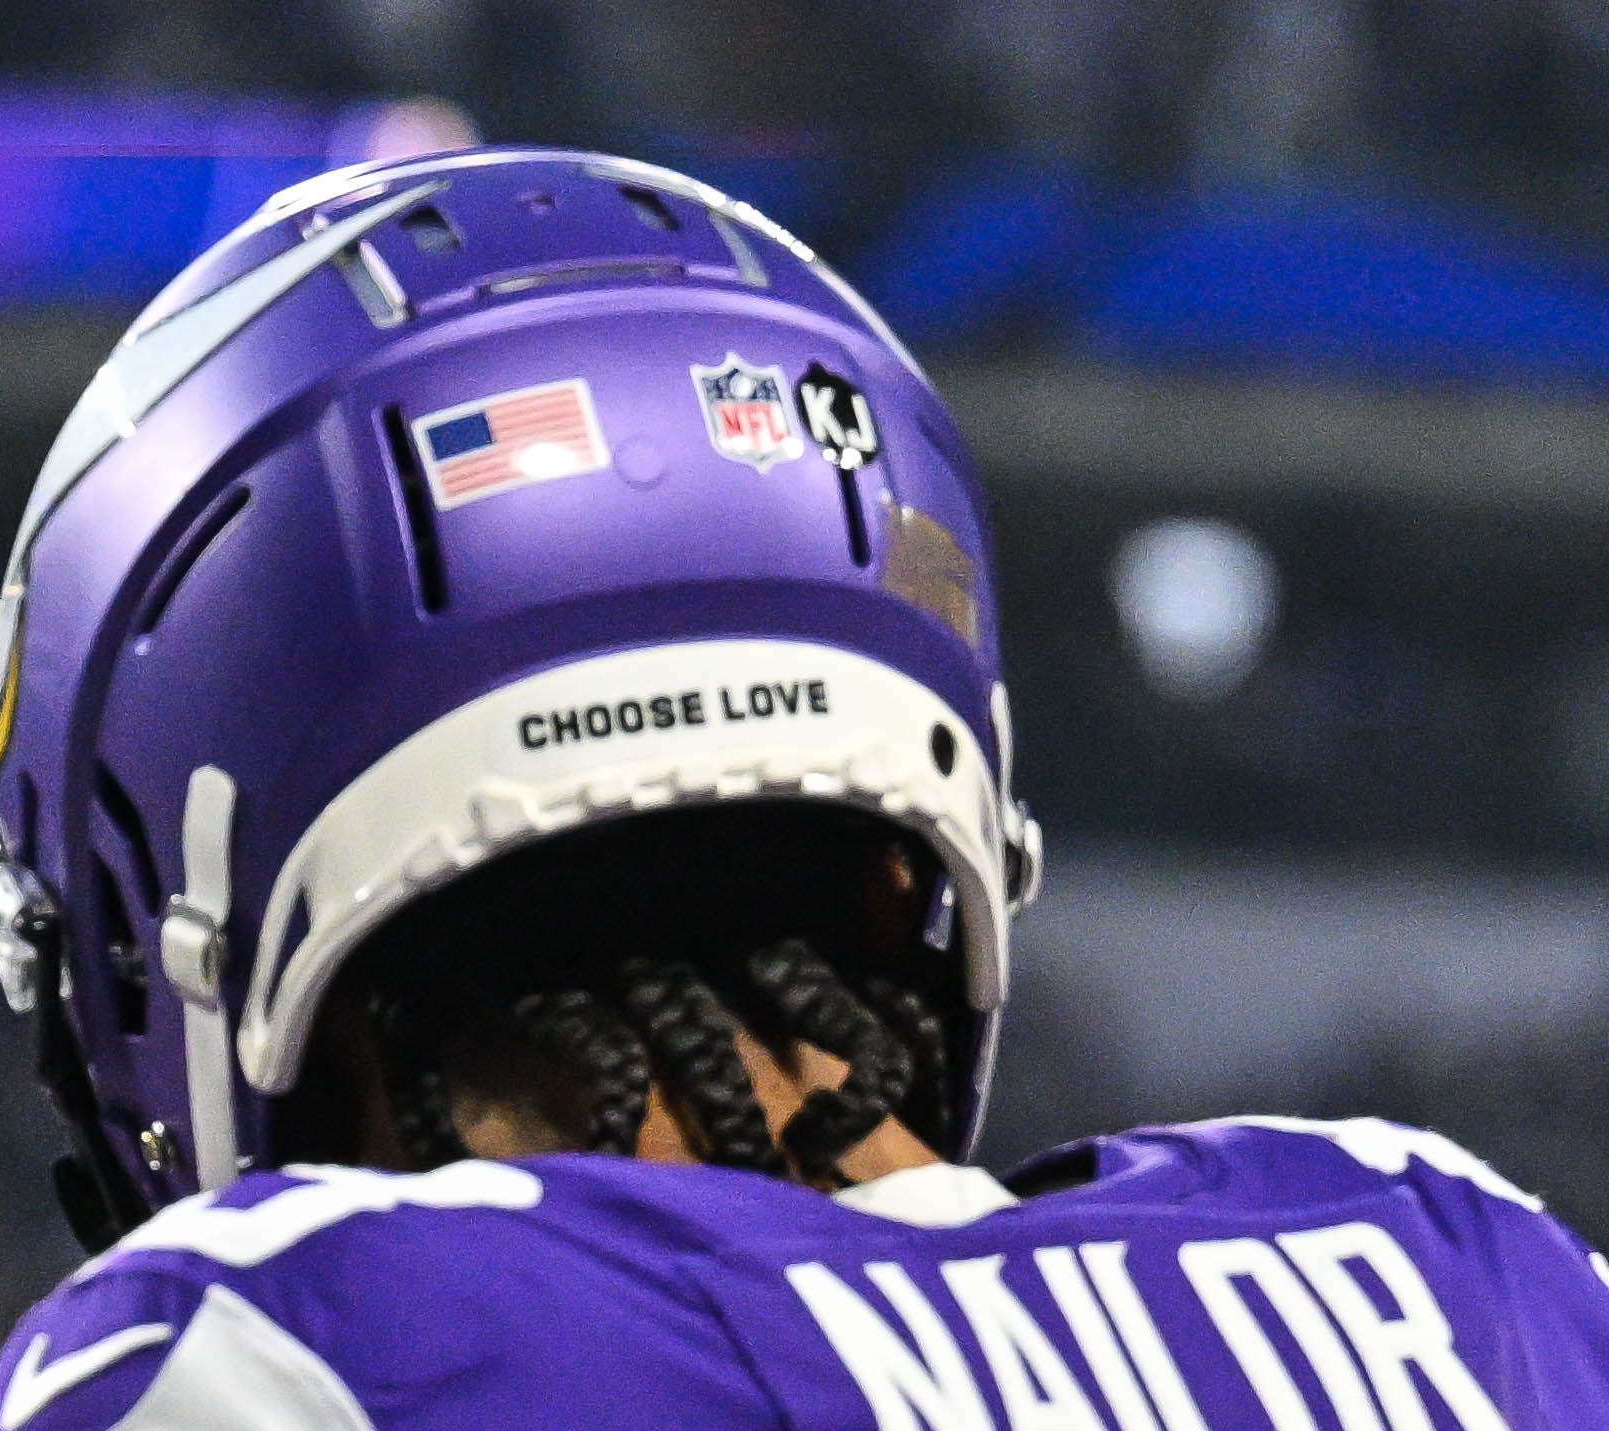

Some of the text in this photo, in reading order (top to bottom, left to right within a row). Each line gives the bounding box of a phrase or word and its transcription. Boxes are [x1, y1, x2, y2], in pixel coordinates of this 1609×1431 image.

[800, 382, 878, 451] KJ
[518, 679, 829, 750] CHOOSE LOVE
